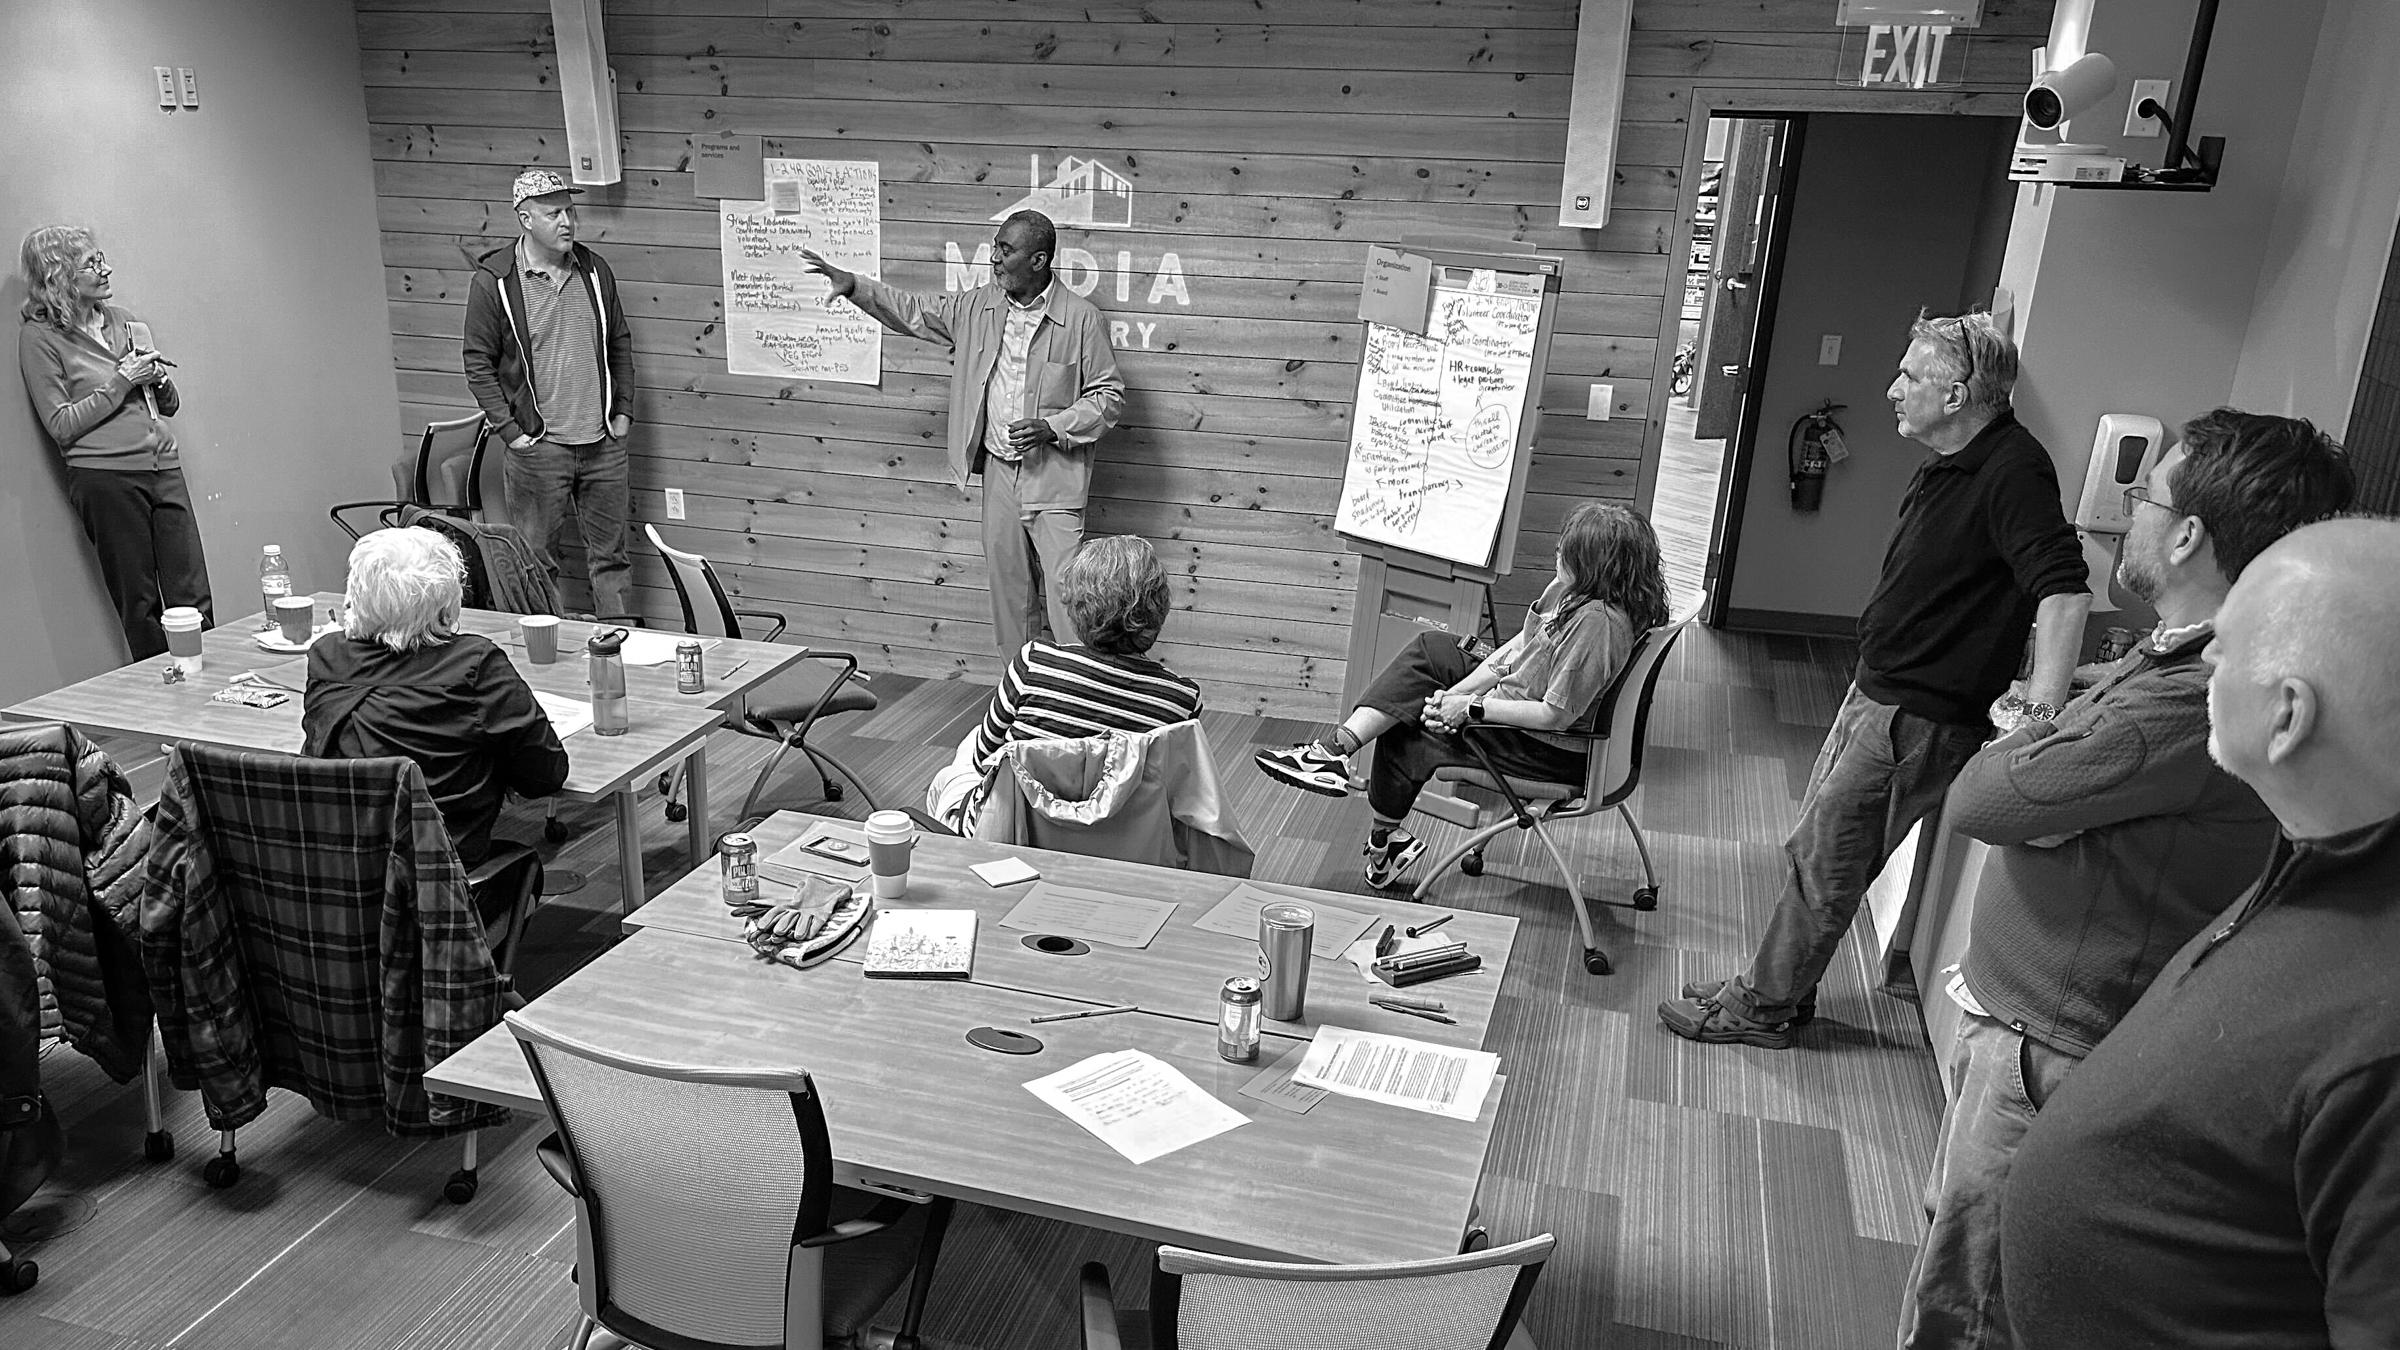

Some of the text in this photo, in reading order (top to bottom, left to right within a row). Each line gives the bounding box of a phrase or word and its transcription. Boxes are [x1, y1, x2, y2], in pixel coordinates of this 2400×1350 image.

[1862, 25, 1952, 83] EXIT
[701, 143, 728, 152] Programs
[1376, 258, 1411, 272] Organization
[945, 241, 1191, 306] MDIA
[1491, 307, 1531, 322] Coordinator
[1449, 360, 1463, 373] HR
